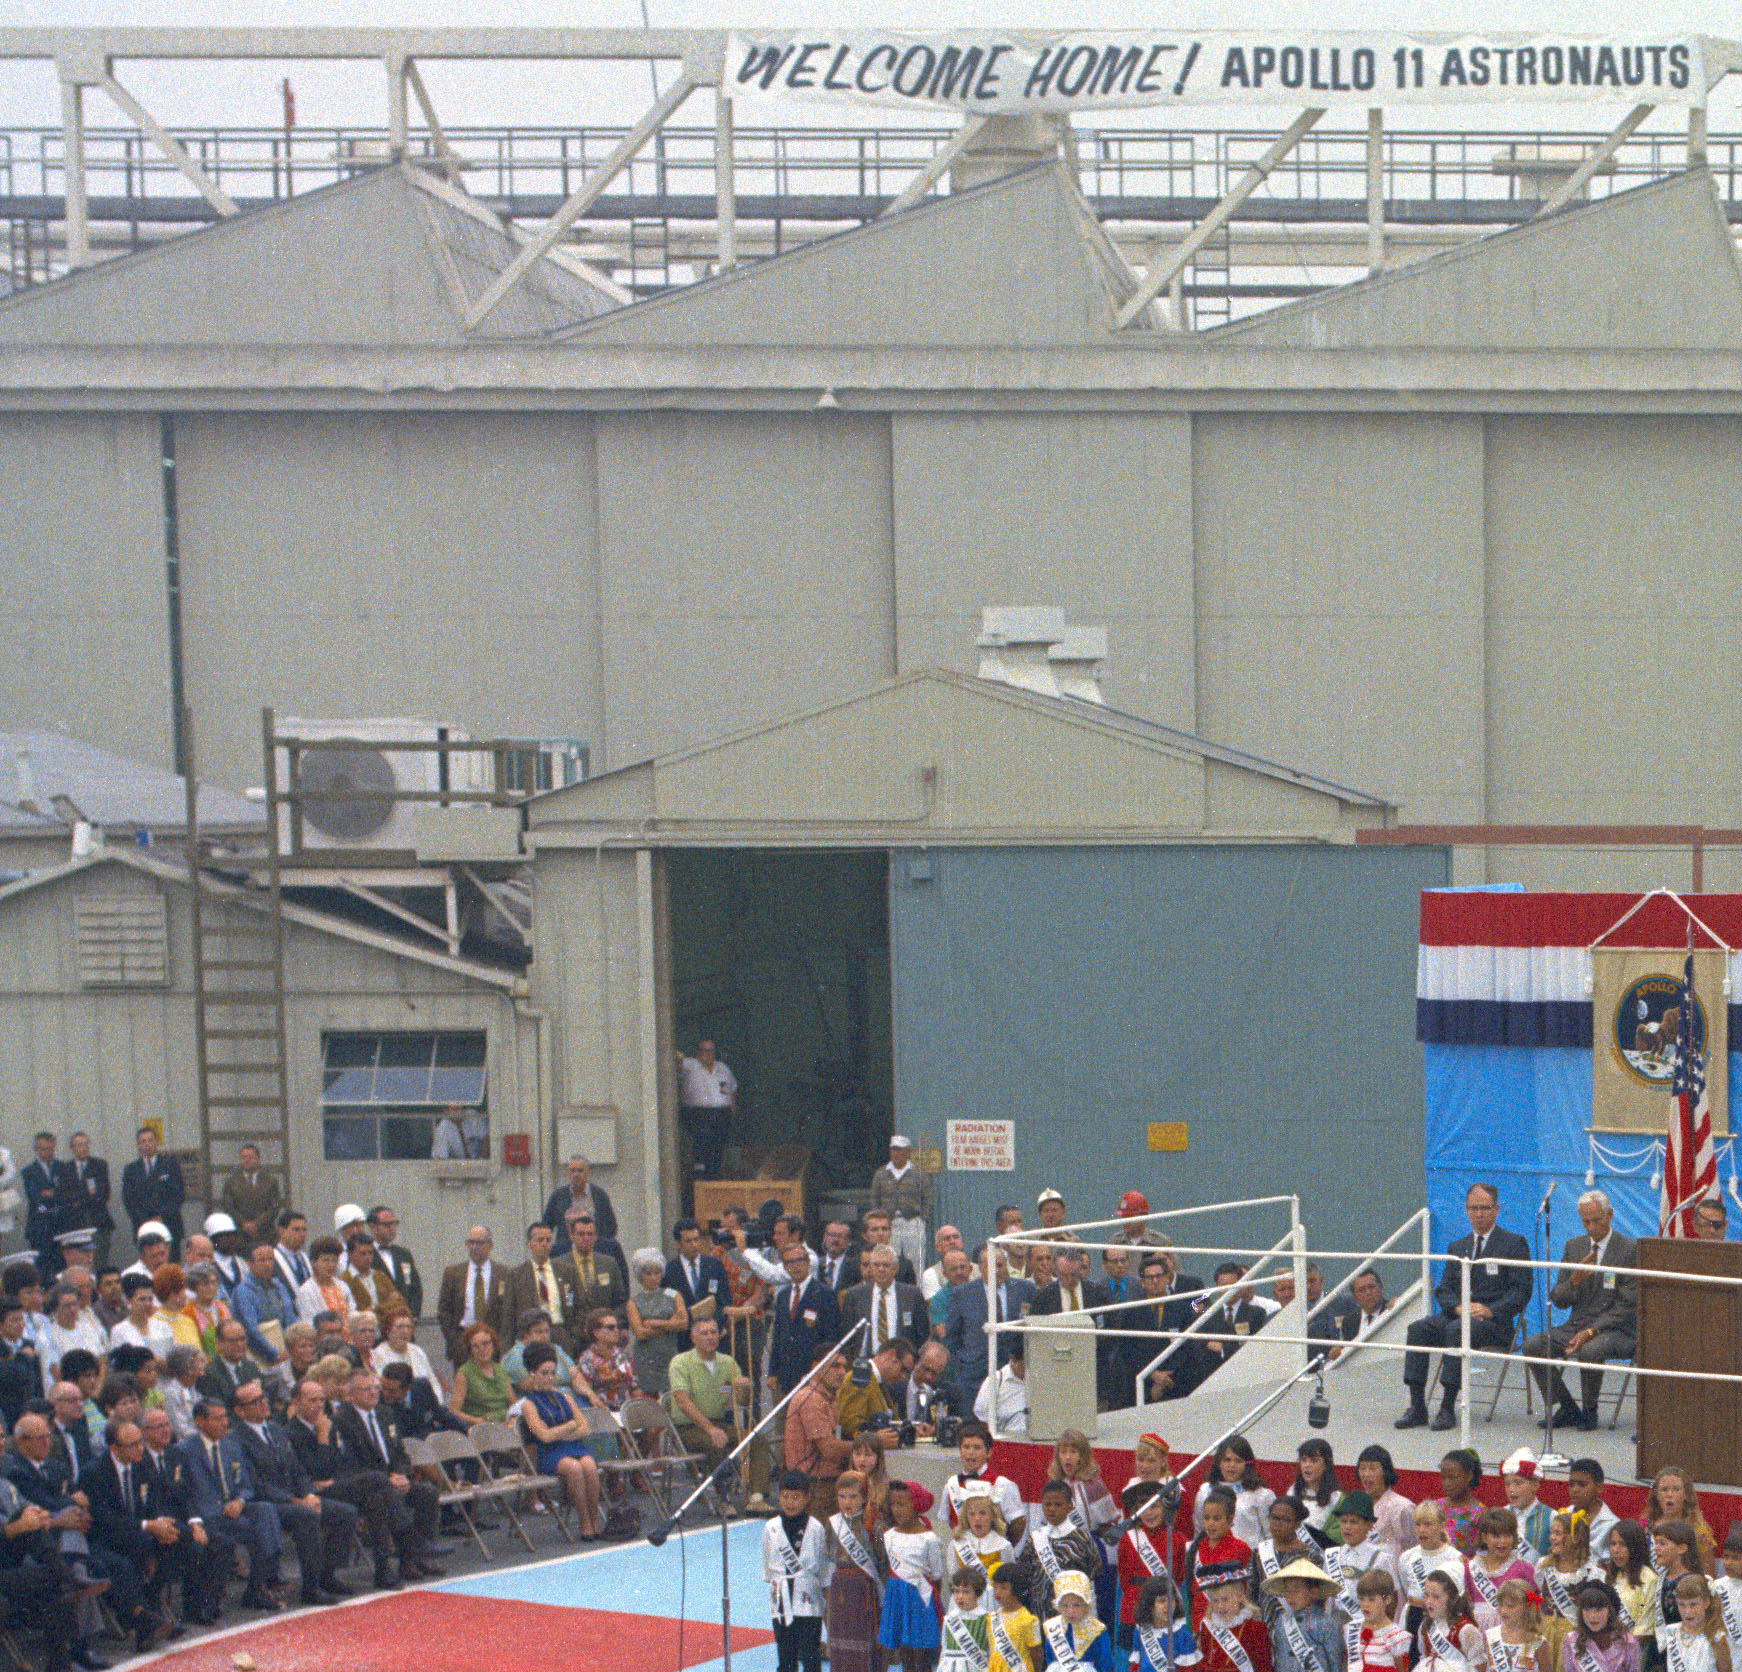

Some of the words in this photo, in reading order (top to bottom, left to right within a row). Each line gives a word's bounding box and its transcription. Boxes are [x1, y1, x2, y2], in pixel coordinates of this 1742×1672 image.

[737, 44, 1014, 100] WELCOME
[1023, 42, 1202, 98] HOME!
[1220, 46, 1375, 91] APOLLO
[1393, 47, 1424, 88] 11
[1440, 45, 1690, 89] ASTRONAUTS
[1636, 981, 1677, 998] APOLLO
[954, 1123, 1006, 1133] RADIATION
[779, 1544, 803, 1574] JAPAN
[840, 1530, 870, 1567] TUNISIA
[1211, 1626, 1249, 1667] ENGLAND
[1347, 1622, 1361, 1664] PANAMA
